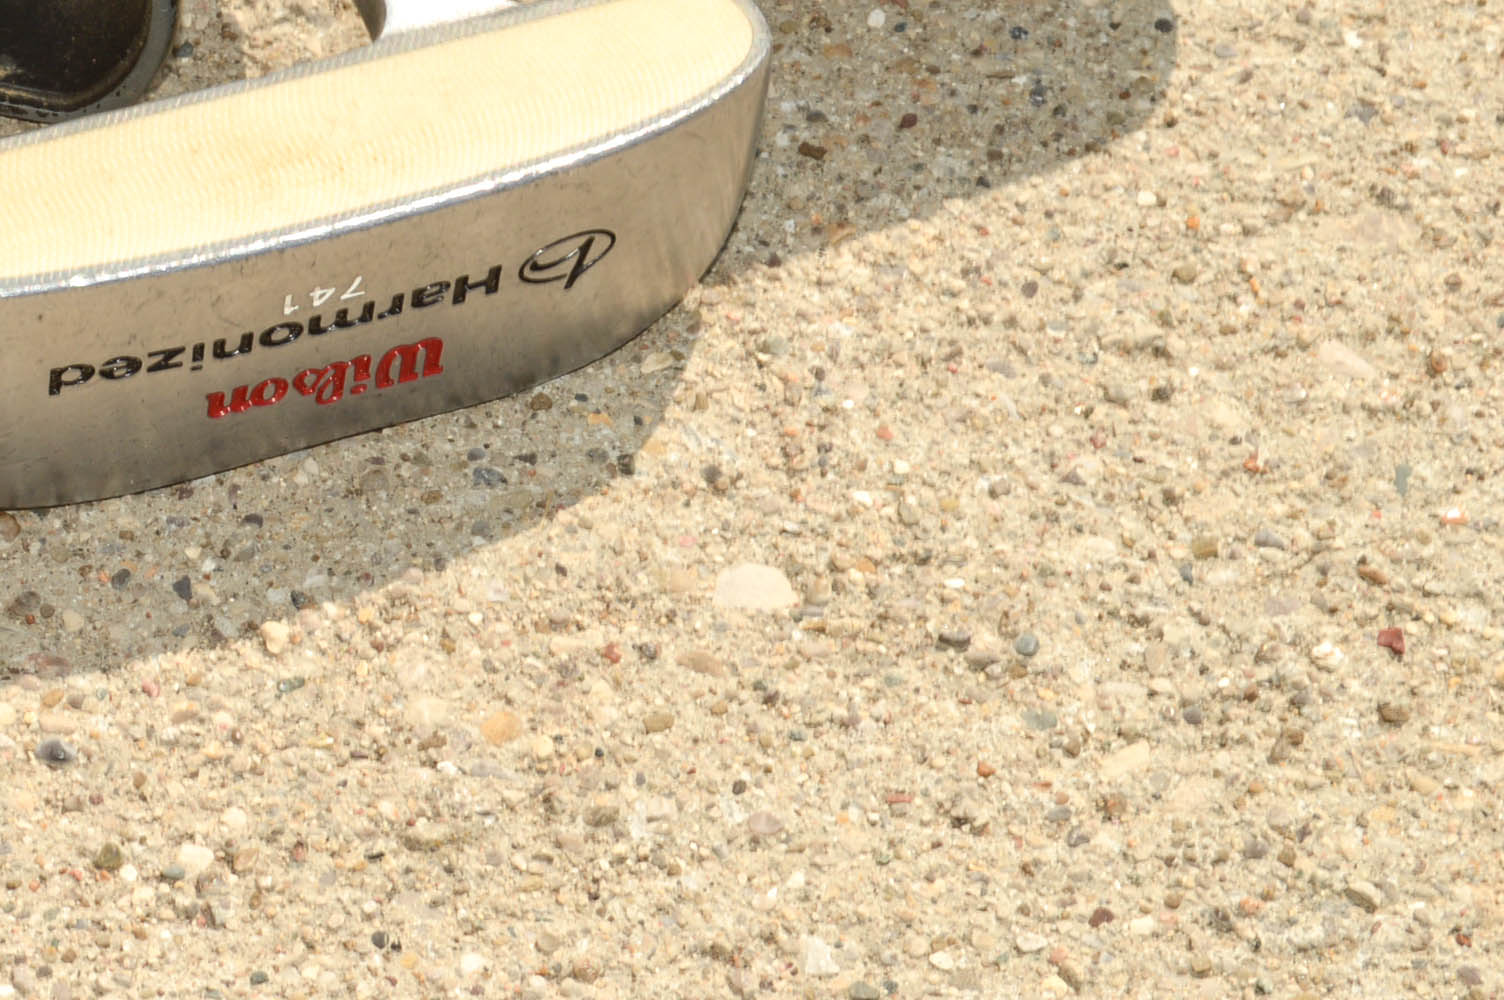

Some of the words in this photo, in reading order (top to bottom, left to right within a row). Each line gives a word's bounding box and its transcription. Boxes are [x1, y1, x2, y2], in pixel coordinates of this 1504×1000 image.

[48, 263, 502, 395] Harmonized
[283, 275, 365, 315] 741
[206, 337, 444, 418] Wilson
